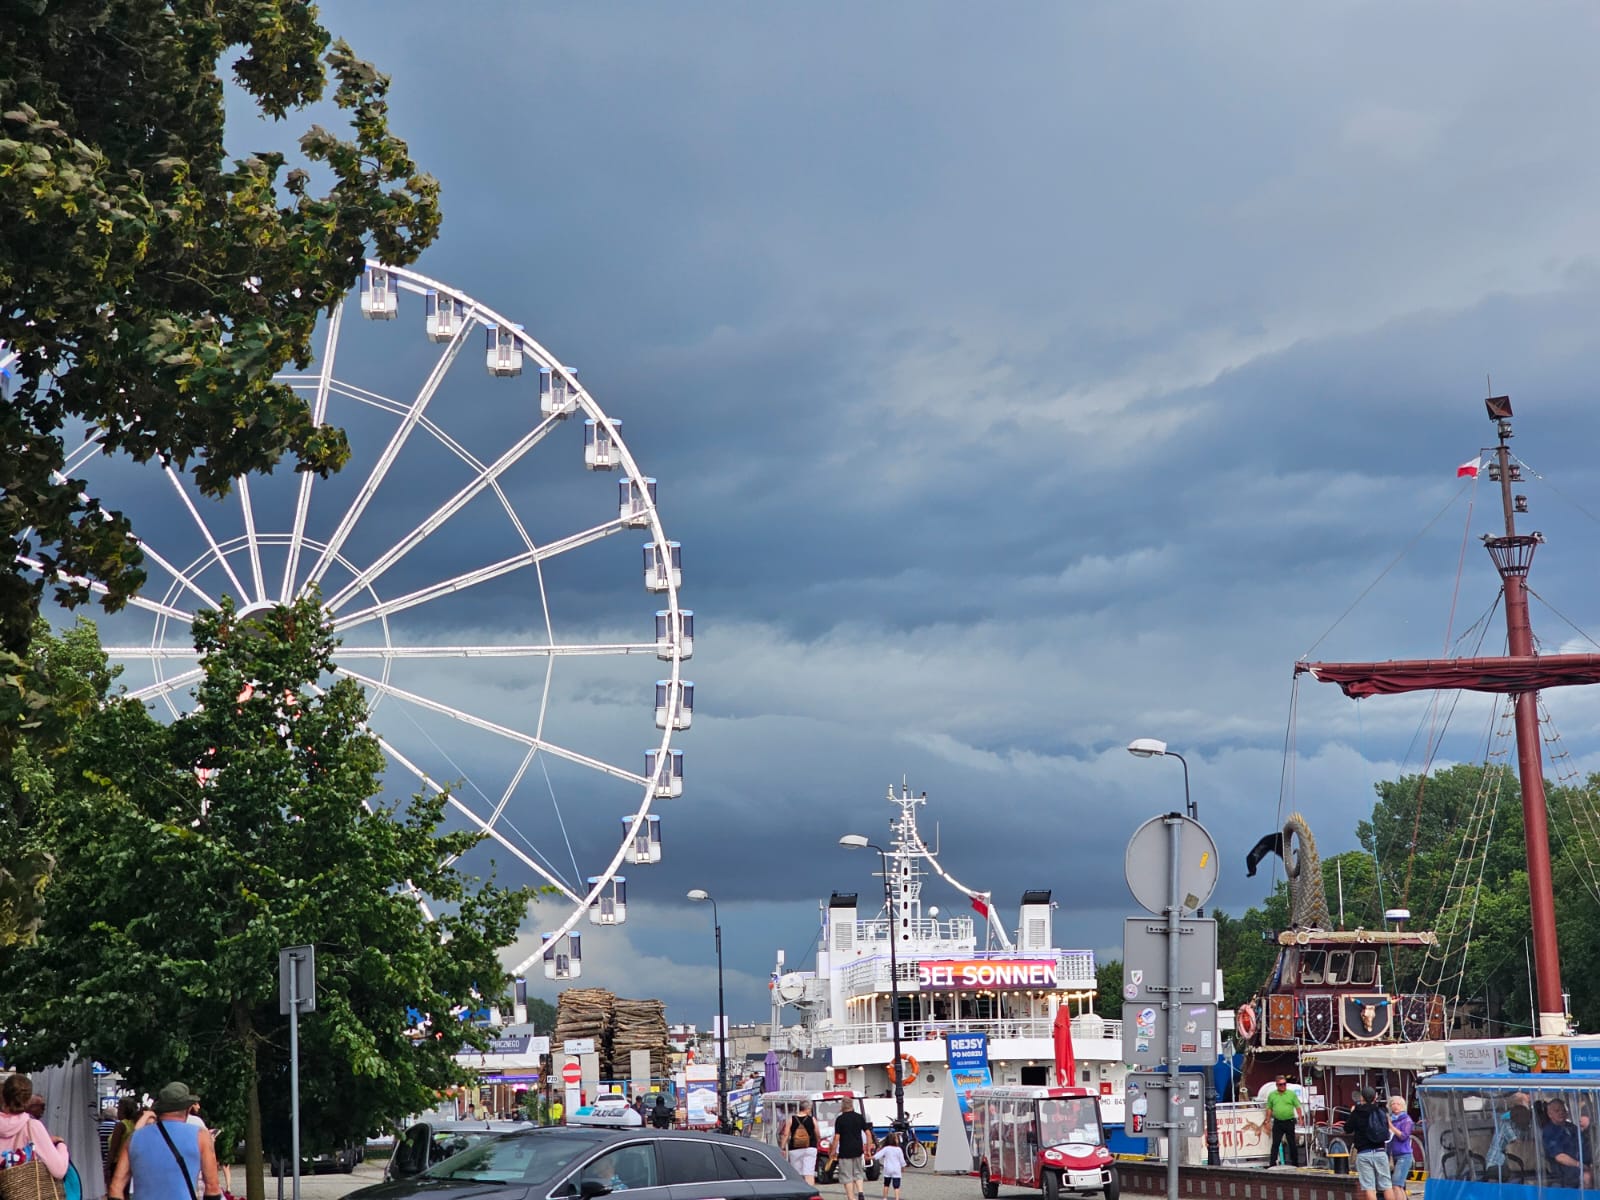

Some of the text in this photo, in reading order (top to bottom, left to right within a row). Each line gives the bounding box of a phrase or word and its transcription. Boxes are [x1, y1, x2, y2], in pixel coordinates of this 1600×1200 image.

[920, 965, 1057, 986] BEI SONNEN
[951, 1038, 984, 1050] REJSY
